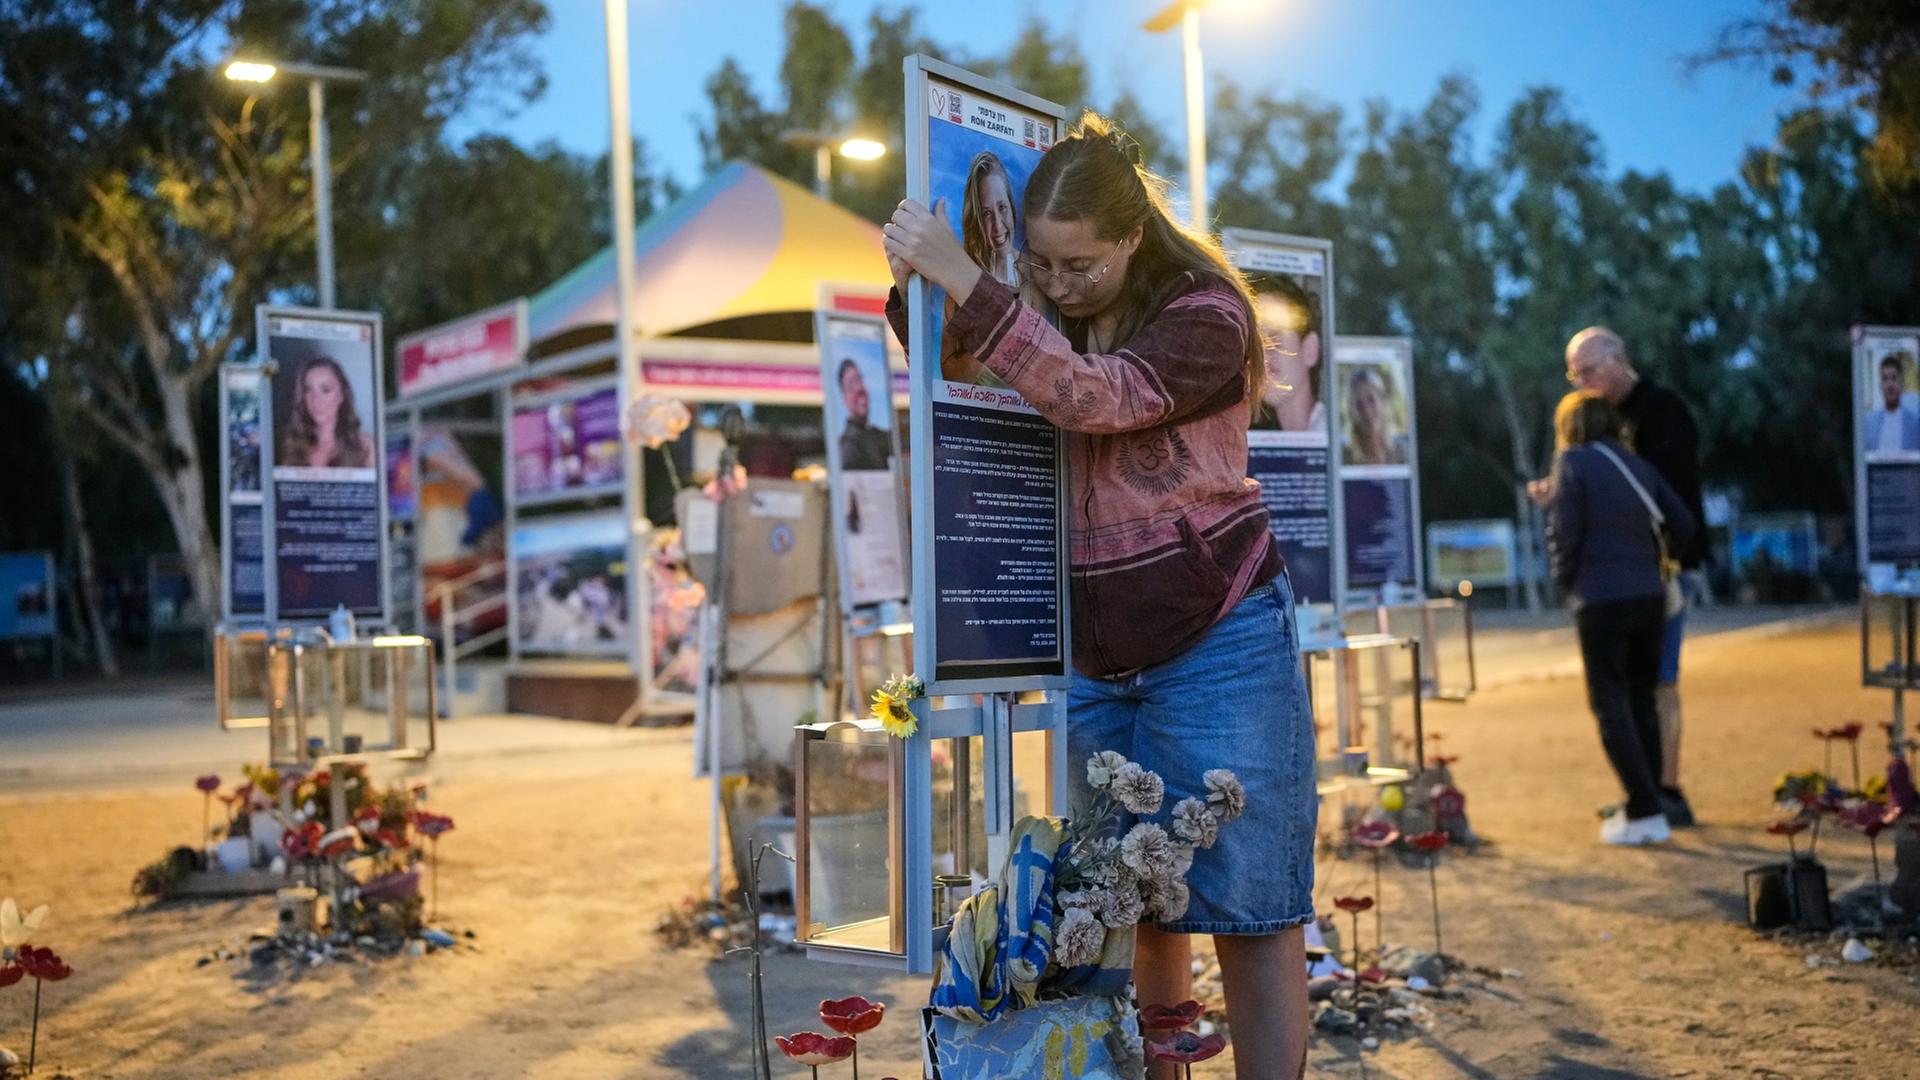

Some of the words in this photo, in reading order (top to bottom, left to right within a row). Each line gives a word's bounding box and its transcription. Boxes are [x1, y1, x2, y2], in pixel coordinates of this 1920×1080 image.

[997, 113, 1005, 122] רון
[971, 116, 986, 127] RON
[987, 121, 1014, 136] ZARFATI
